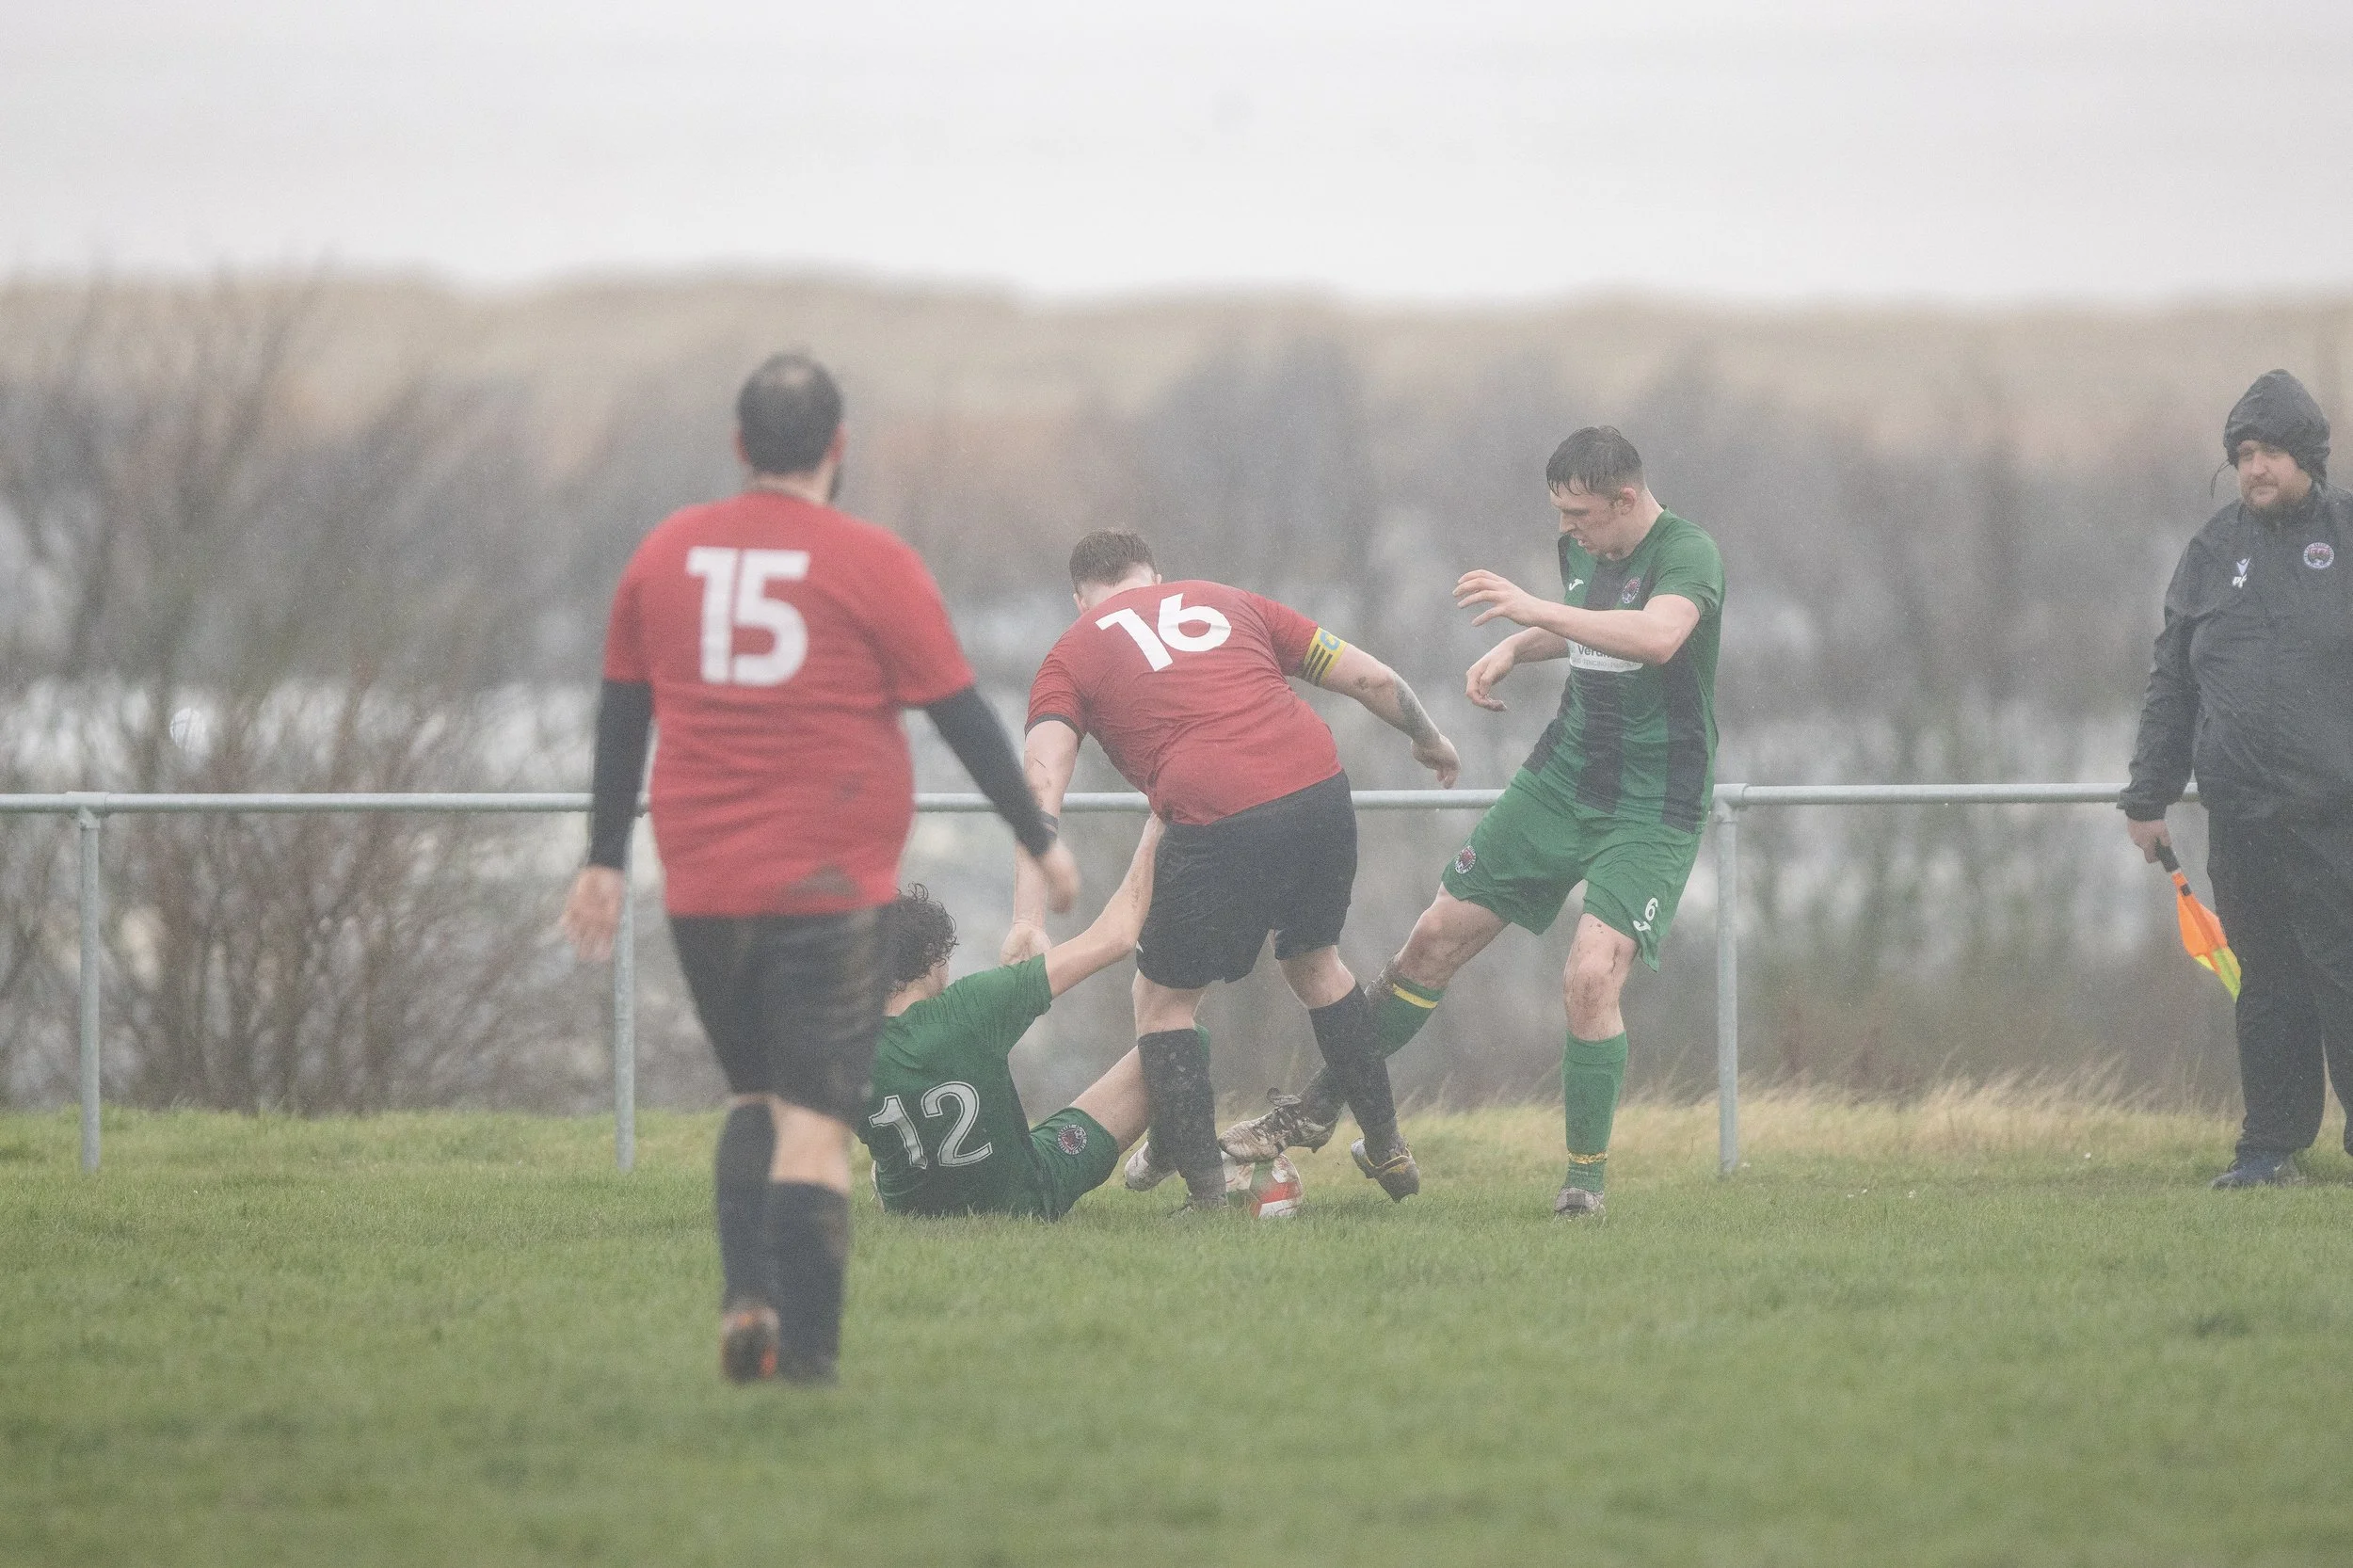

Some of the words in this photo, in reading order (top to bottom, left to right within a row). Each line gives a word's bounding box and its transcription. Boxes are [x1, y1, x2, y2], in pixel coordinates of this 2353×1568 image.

[687, 546, 810, 686] 15
[1095, 593, 1232, 672] 16
[1645, 898, 1658, 920] 6
[869, 1080, 993, 1169] 12
